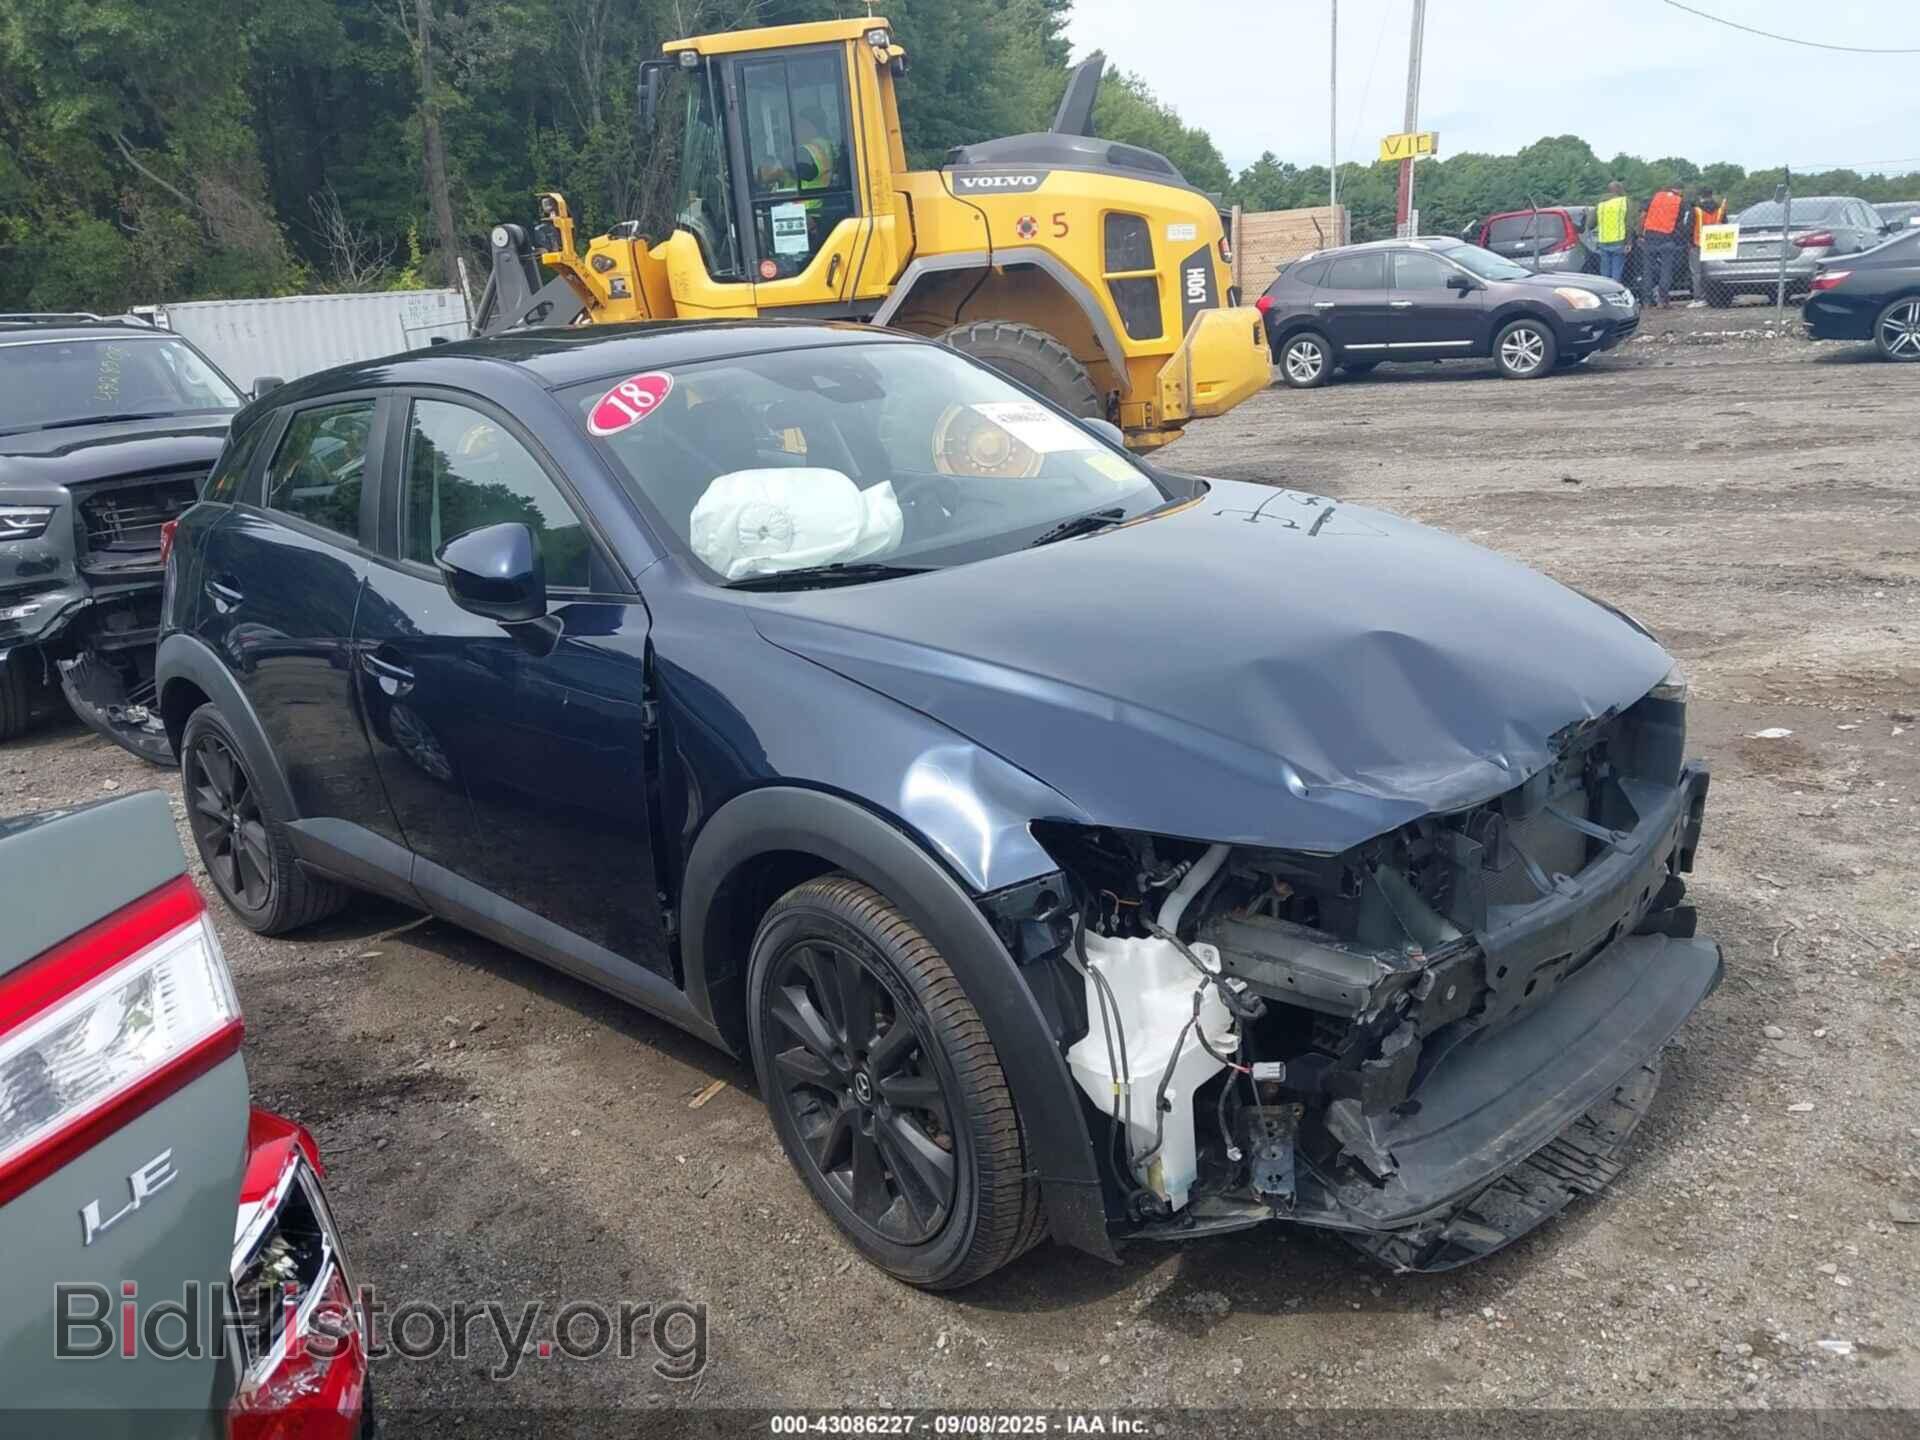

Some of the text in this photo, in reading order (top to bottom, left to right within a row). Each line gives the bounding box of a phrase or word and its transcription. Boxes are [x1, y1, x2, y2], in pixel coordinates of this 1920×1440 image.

[960, 175, 1038, 188] VOLVO
[1052, 212, 1069, 238] 5
[1186, 267, 1207, 304] L90H
[606, 383, 655, 422] 18
[79, 1147, 178, 1247] LE
